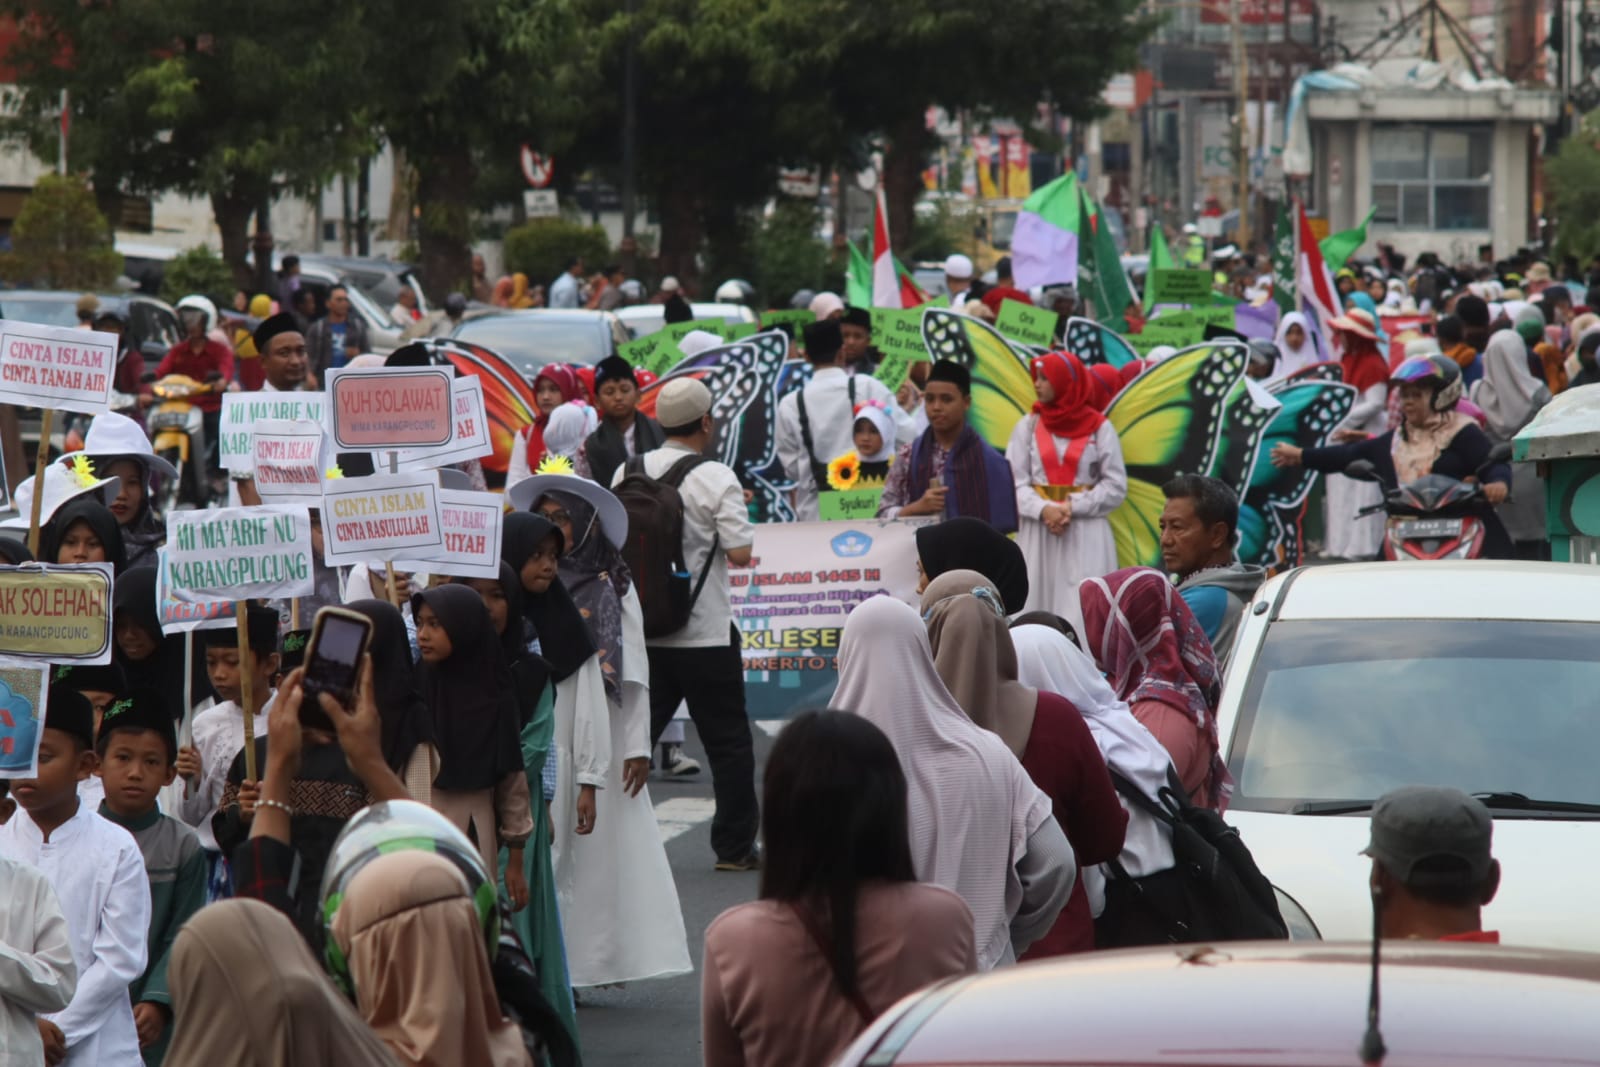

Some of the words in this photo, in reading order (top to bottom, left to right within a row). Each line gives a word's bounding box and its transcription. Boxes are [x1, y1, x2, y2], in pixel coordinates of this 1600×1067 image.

[9, 341, 52, 363] CINTA
[57, 347, 104, 368] ISLAM
[904, 338, 926, 352] Ind
[3, 363, 37, 385] CINTA
[40, 367, 82, 389] TANAH
[84, 372, 105, 392] AIR
[340, 390, 372, 414] YUH
[375, 388, 442, 413] SOLAWAT
[257, 441, 286, 459] CINTA
[287, 441, 315, 459] ISLAM
[334, 496, 378, 517] CINTA
[381, 492, 426, 513] ISLAM
[840, 494, 875, 514] Syukuri
[336, 522, 366, 542] CINTA
[367, 515, 430, 540] RASULULLAH
[462, 510, 488, 529] BARU
[176, 523, 195, 551] MI
[201, 517, 268, 549] MA'ARIF
[274, 514, 297, 543] NU
[170, 552, 308, 589] KARANGPUCUNG
[753, 571, 812, 586] ISLAM
[816, 568, 862, 583] 1445
[864, 568, 880, 582] H
[22, 588, 102, 617] SOLEHAH
[750, 591, 826, 604] Semangat
[741, 605, 809, 617] Moderat
[811, 603, 841, 615] dan
[6, 624, 89, 640] KARANGPUCUNG
